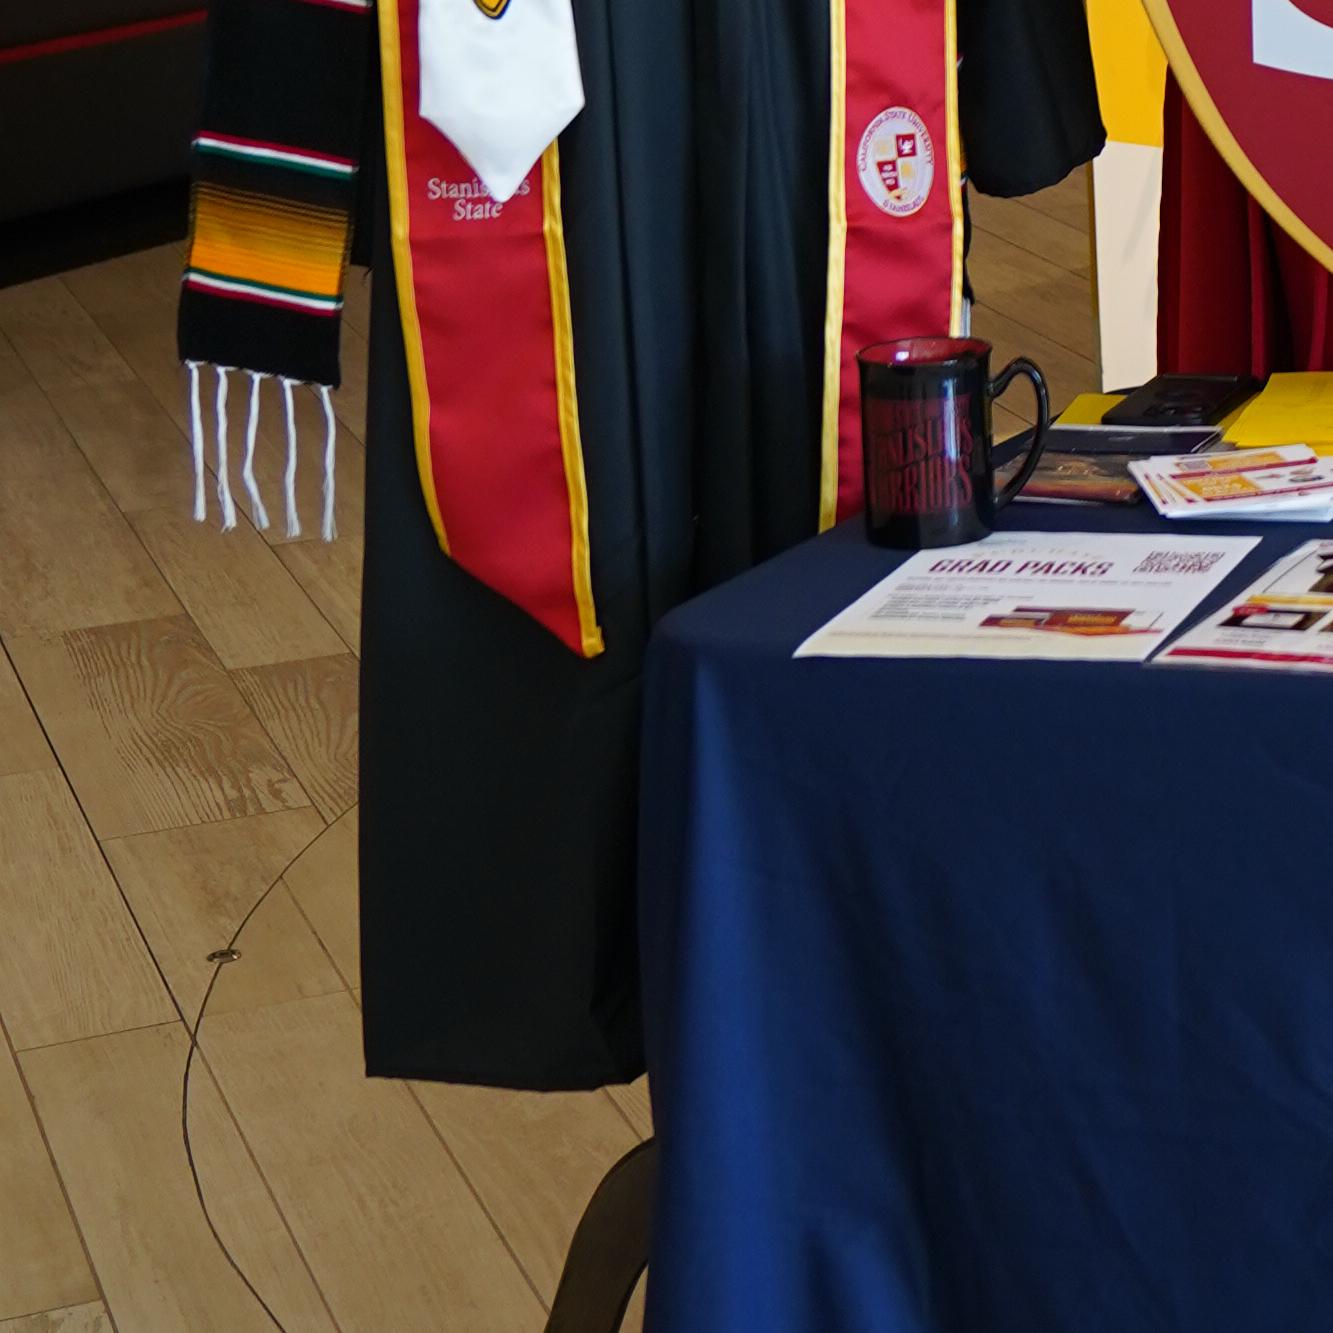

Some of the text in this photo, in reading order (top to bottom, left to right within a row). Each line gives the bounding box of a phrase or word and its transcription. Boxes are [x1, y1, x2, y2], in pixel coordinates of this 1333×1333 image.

[427, 177, 531, 200] Staniss
[452, 198, 503, 221] State
[928, 558, 1115, 576] GRAD PACKS
